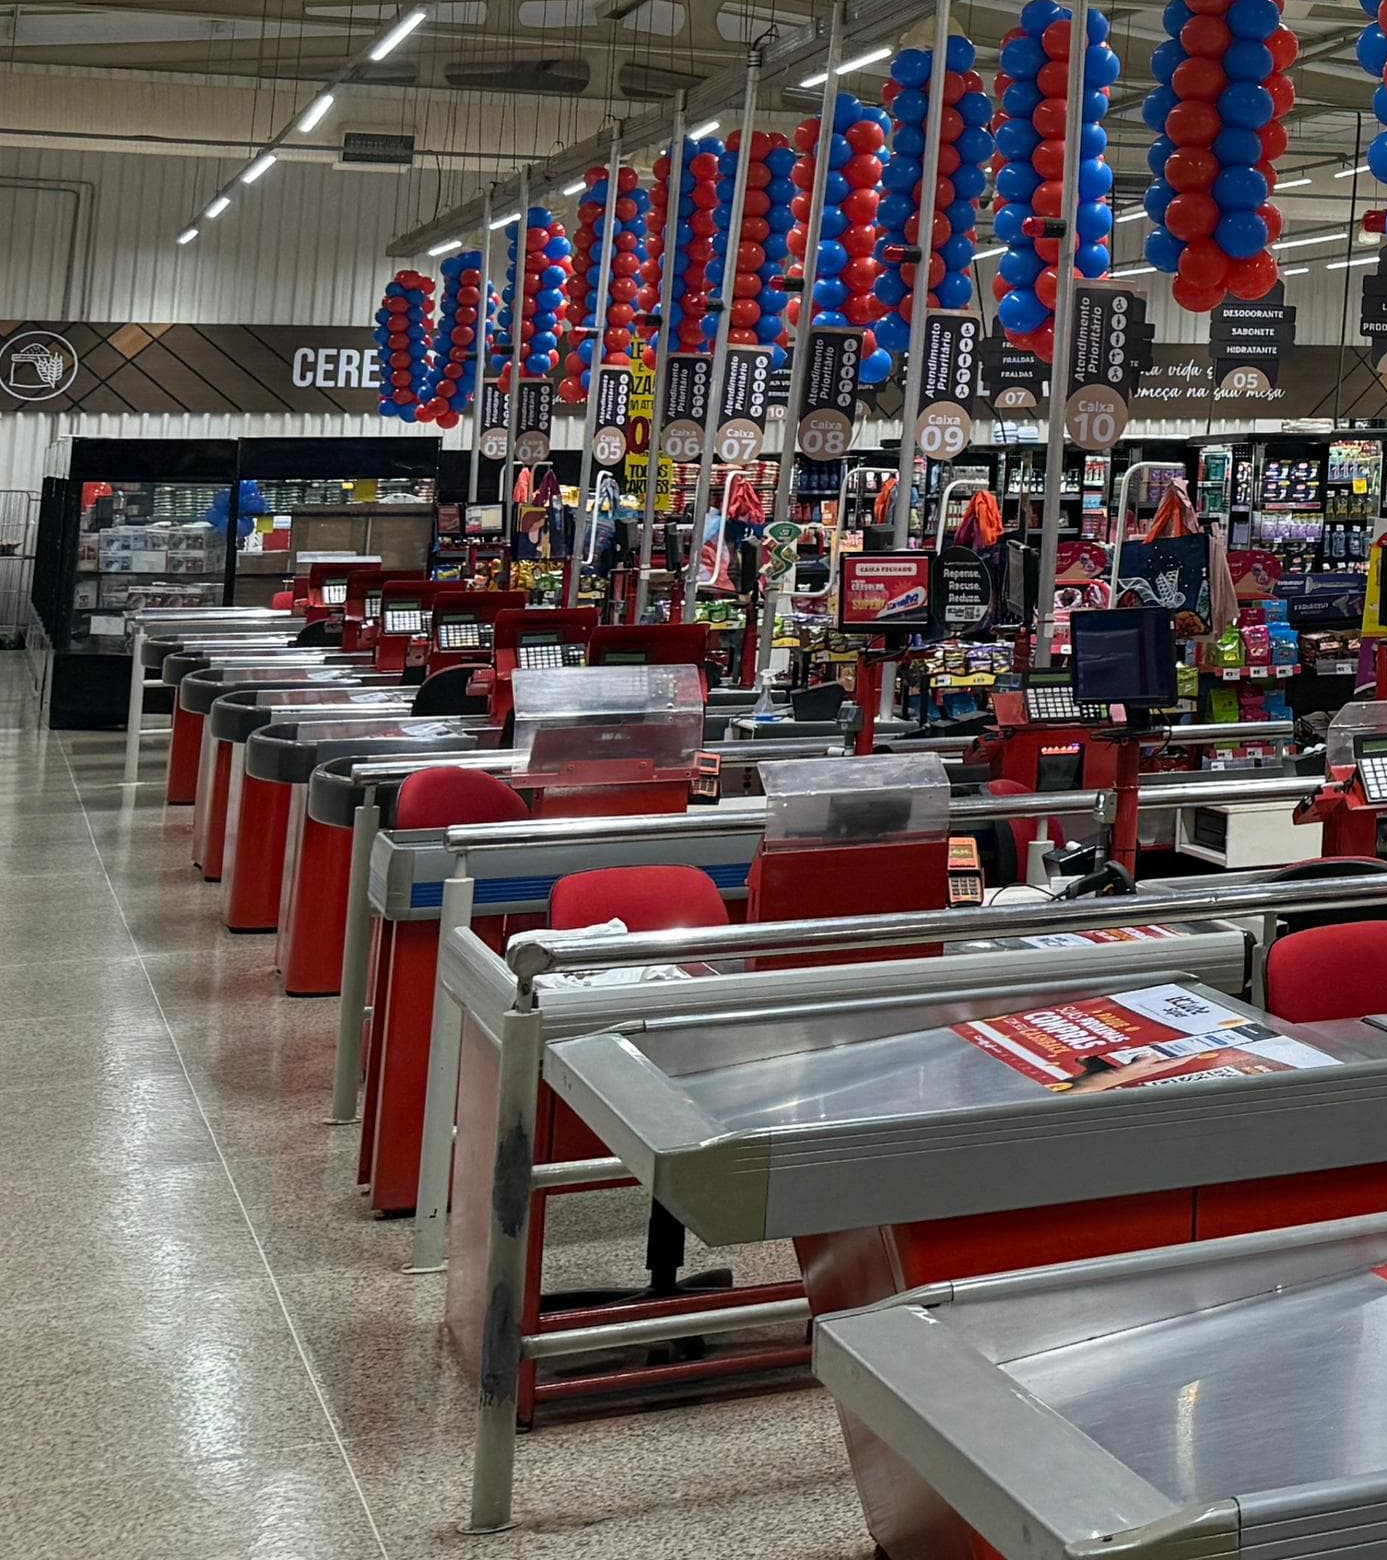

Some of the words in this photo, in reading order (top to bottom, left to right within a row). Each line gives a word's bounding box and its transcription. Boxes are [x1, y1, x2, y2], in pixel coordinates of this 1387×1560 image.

[1223, 310, 1283, 318] DESODORANTE
[1075, 297, 1090, 382] Atendimento
[1088, 307, 1102, 373] Prioritário
[1232, 328, 1274, 336] SABONETE
[1227, 346, 1277, 354] HIDRATANTE
[293, 347, 380, 387] CERE
[925, 323, 941, 398] Atendimento
[937, 331, 952, 390] Prioritário
[808, 339, 823, 405] Atendimento
[820, 347, 834, 400] Prioritário
[1168, 359, 1201, 382] vida
[724, 356, 739, 416] Atendimento
[735, 363, 748, 410] Prioritário
[1234, 374, 1258, 388] 05
[1005, 392, 1026, 405] 07
[1186, 388, 1209, 398] na
[1246, 389, 1285, 400] mesa
[769, 409, 784, 417] 10
[1078, 401, 1115, 413] Caixa
[810, 420, 842, 430] Caixa
[928, 415, 960, 425] Caixa
[1074, 413, 1115, 442] 10
[671, 429, 696, 437] Caixa
[727, 429, 754, 438] Caixa
[803, 430, 844, 454] 08
[921, 426, 964, 452] 09
[484, 441, 507, 456] 03
[596, 442, 621, 459] 05
[666, 438, 698, 456] 06
[722, 440, 757, 460] 07
[944, 568, 981, 579] Repense,
[1023, 1012, 1107, 1050] COMPRAS
